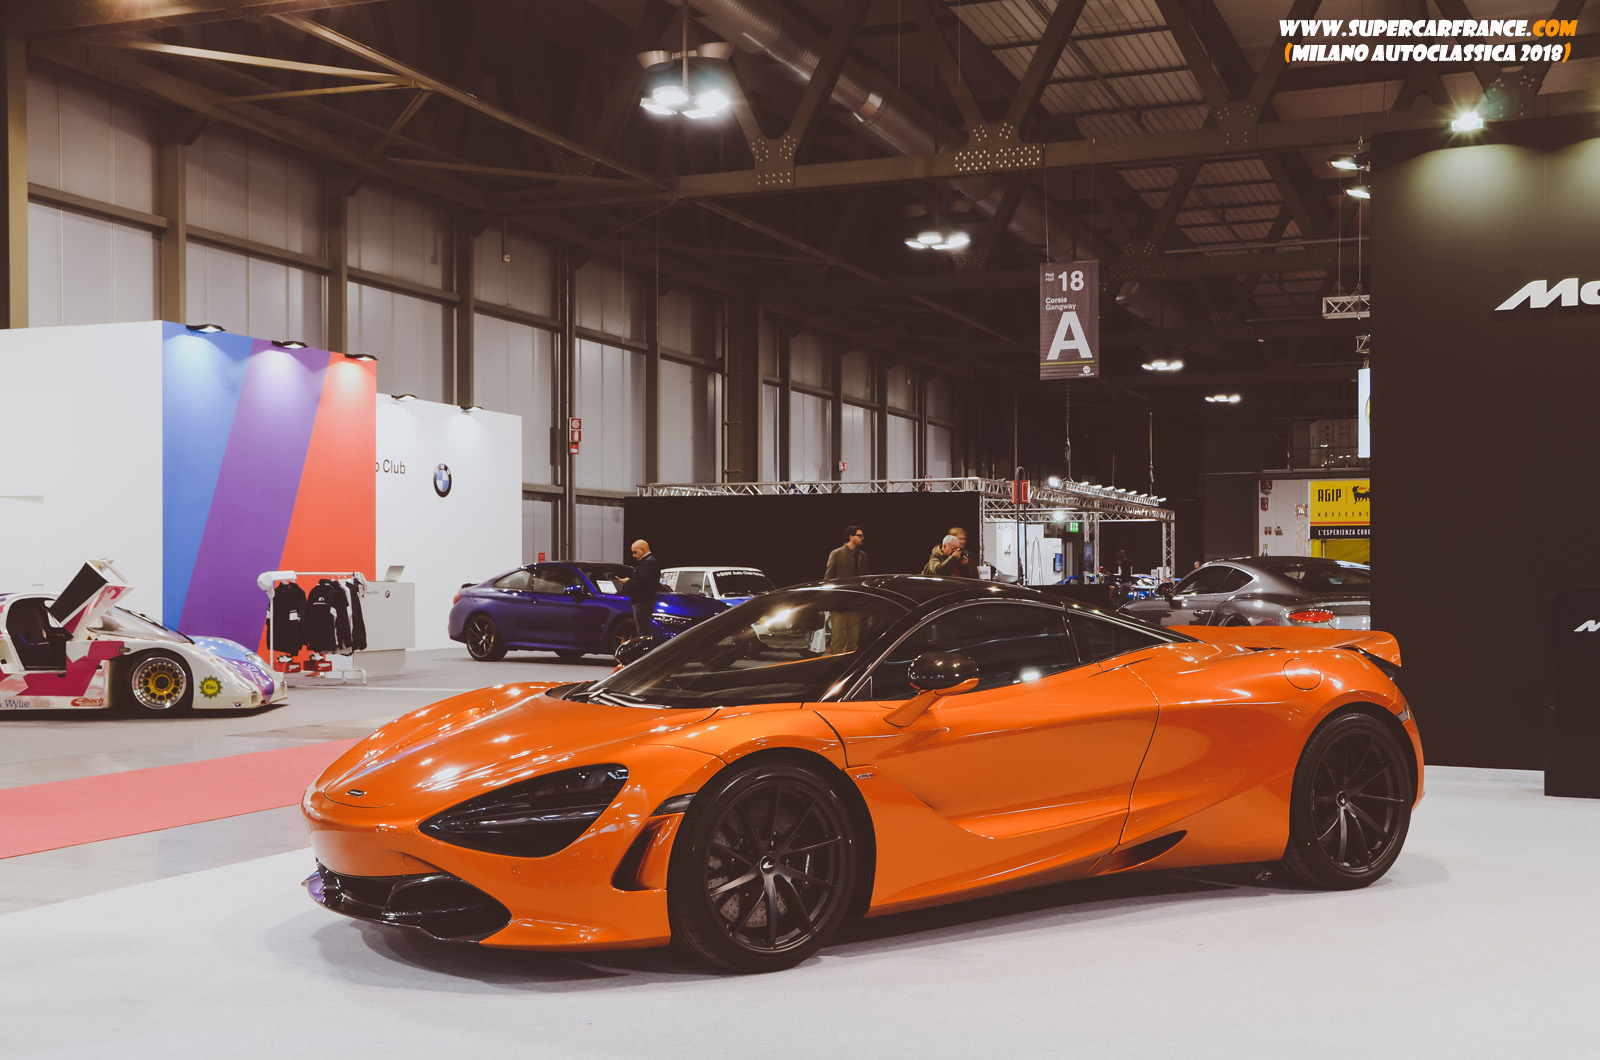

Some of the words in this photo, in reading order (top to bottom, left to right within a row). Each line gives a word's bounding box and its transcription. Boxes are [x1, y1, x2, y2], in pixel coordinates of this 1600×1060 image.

[1057, 270, 1084, 291] 18
[1045, 296, 1067, 304] Corsia
[1045, 303, 1077, 311] Gangway
[1046, 310, 1093, 361] A
[383, 458, 406, 475] Club
[1317, 488, 1342, 502] AGIP
[4, 699, 30, 710] Wylie
